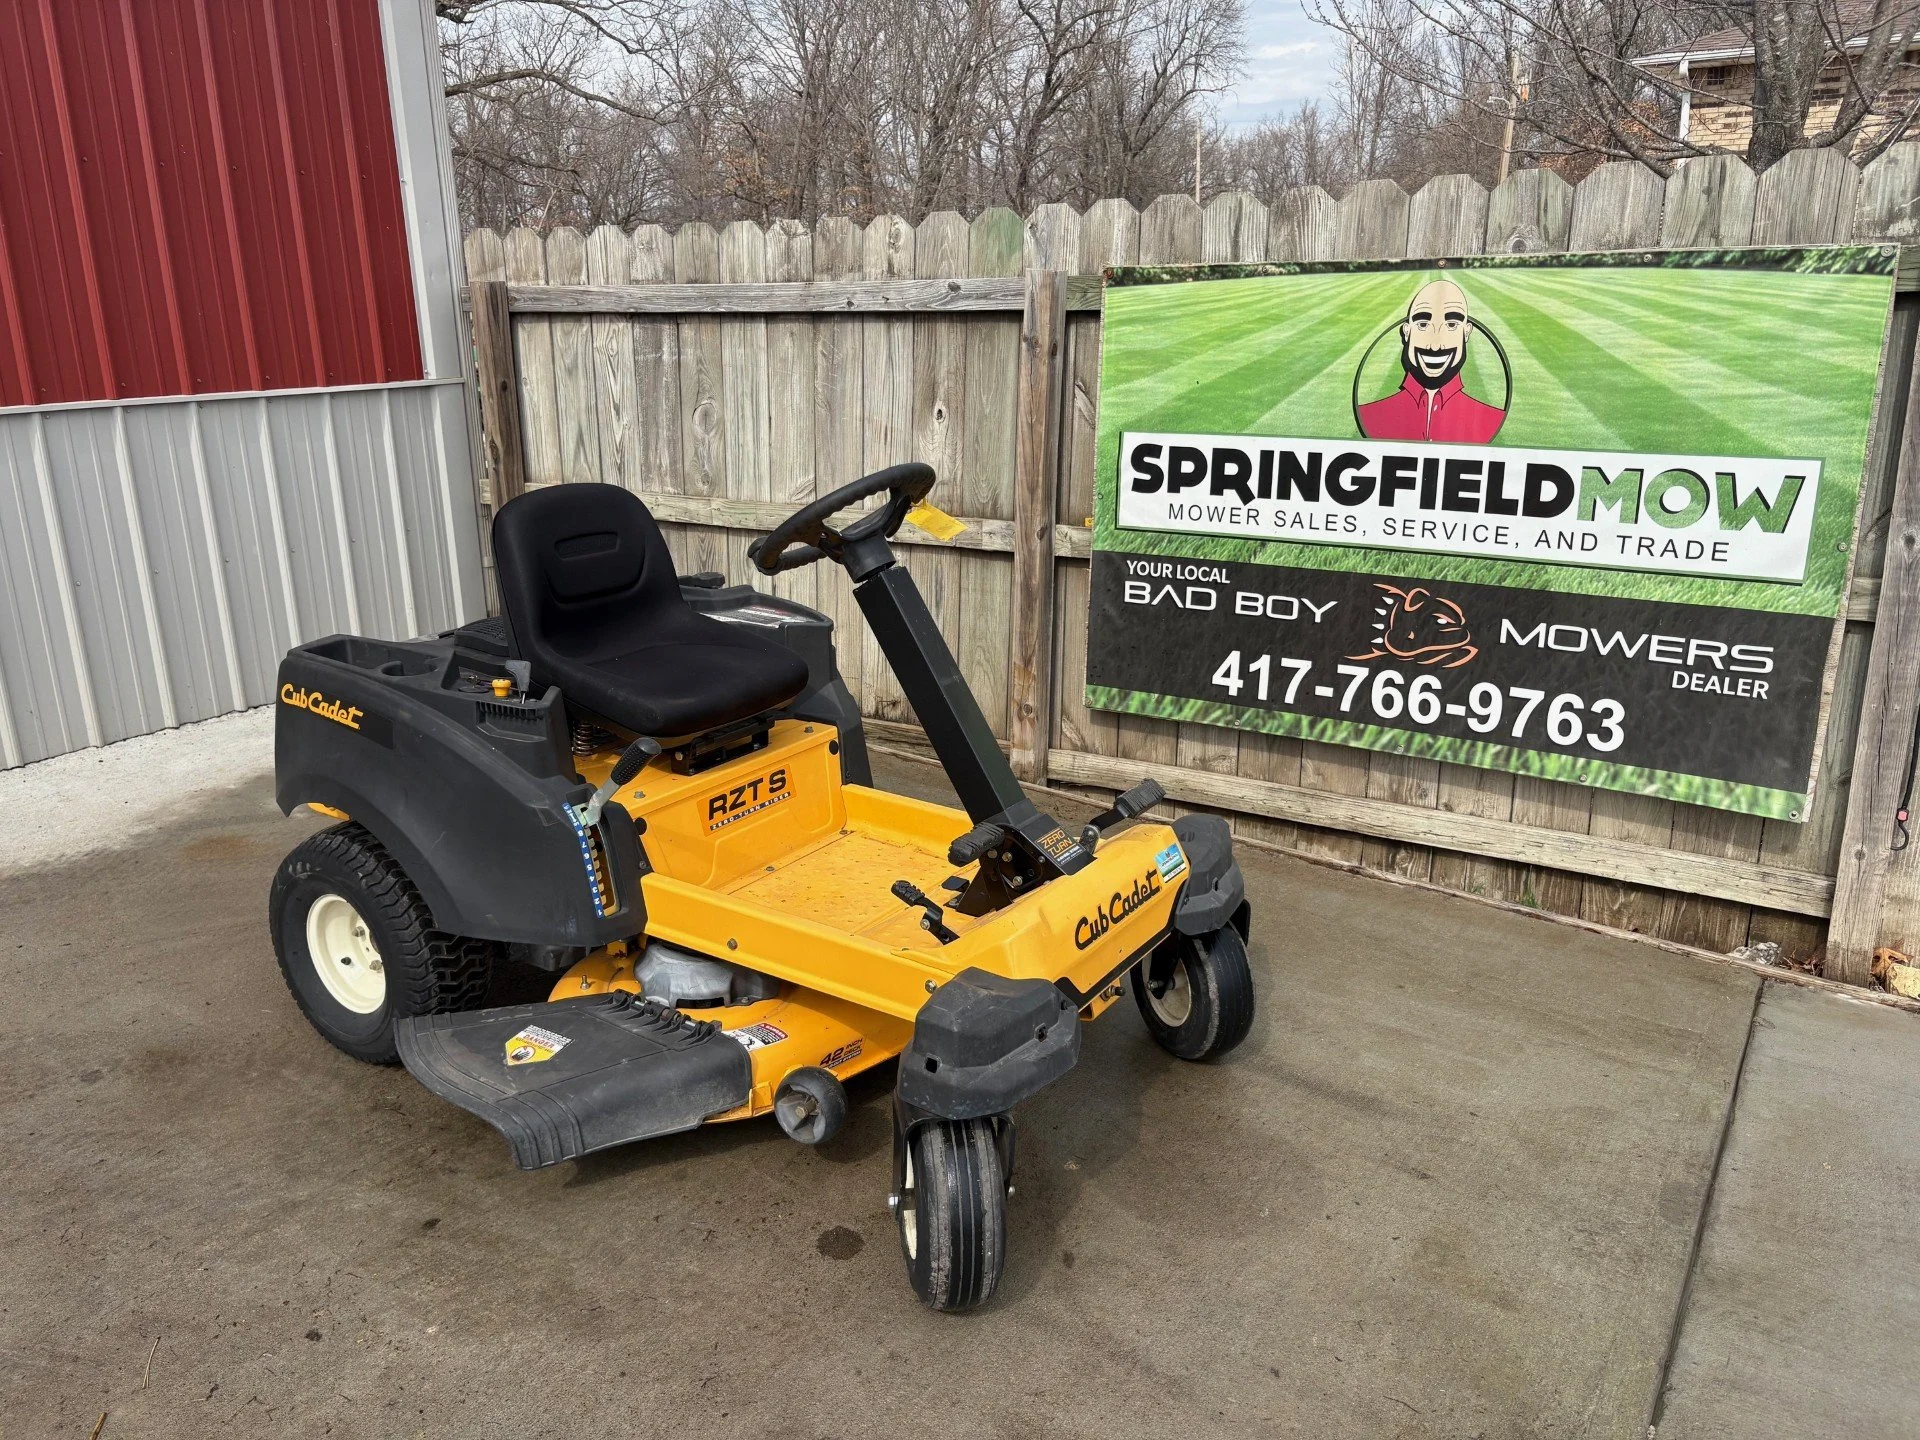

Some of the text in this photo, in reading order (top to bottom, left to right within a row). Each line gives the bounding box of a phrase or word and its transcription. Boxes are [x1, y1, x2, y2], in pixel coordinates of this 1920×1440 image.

[1168, 504, 1730, 562] MOWER SALES, SERVICE, AND TRADE
[1127, 560, 1230, 584] YOUR LOCAL
[1124, 580, 1775, 674] BAD BOY MOWERS
[1671, 670, 1770, 700] DEALER
[1211, 650, 1626, 752] 417-766-9763
[708, 769, 787, 820] RZT S
[1041, 830, 1065, 849] ZERO
[1048, 837, 1072, 856] TURN
[819, 1047, 844, 1066] 42
